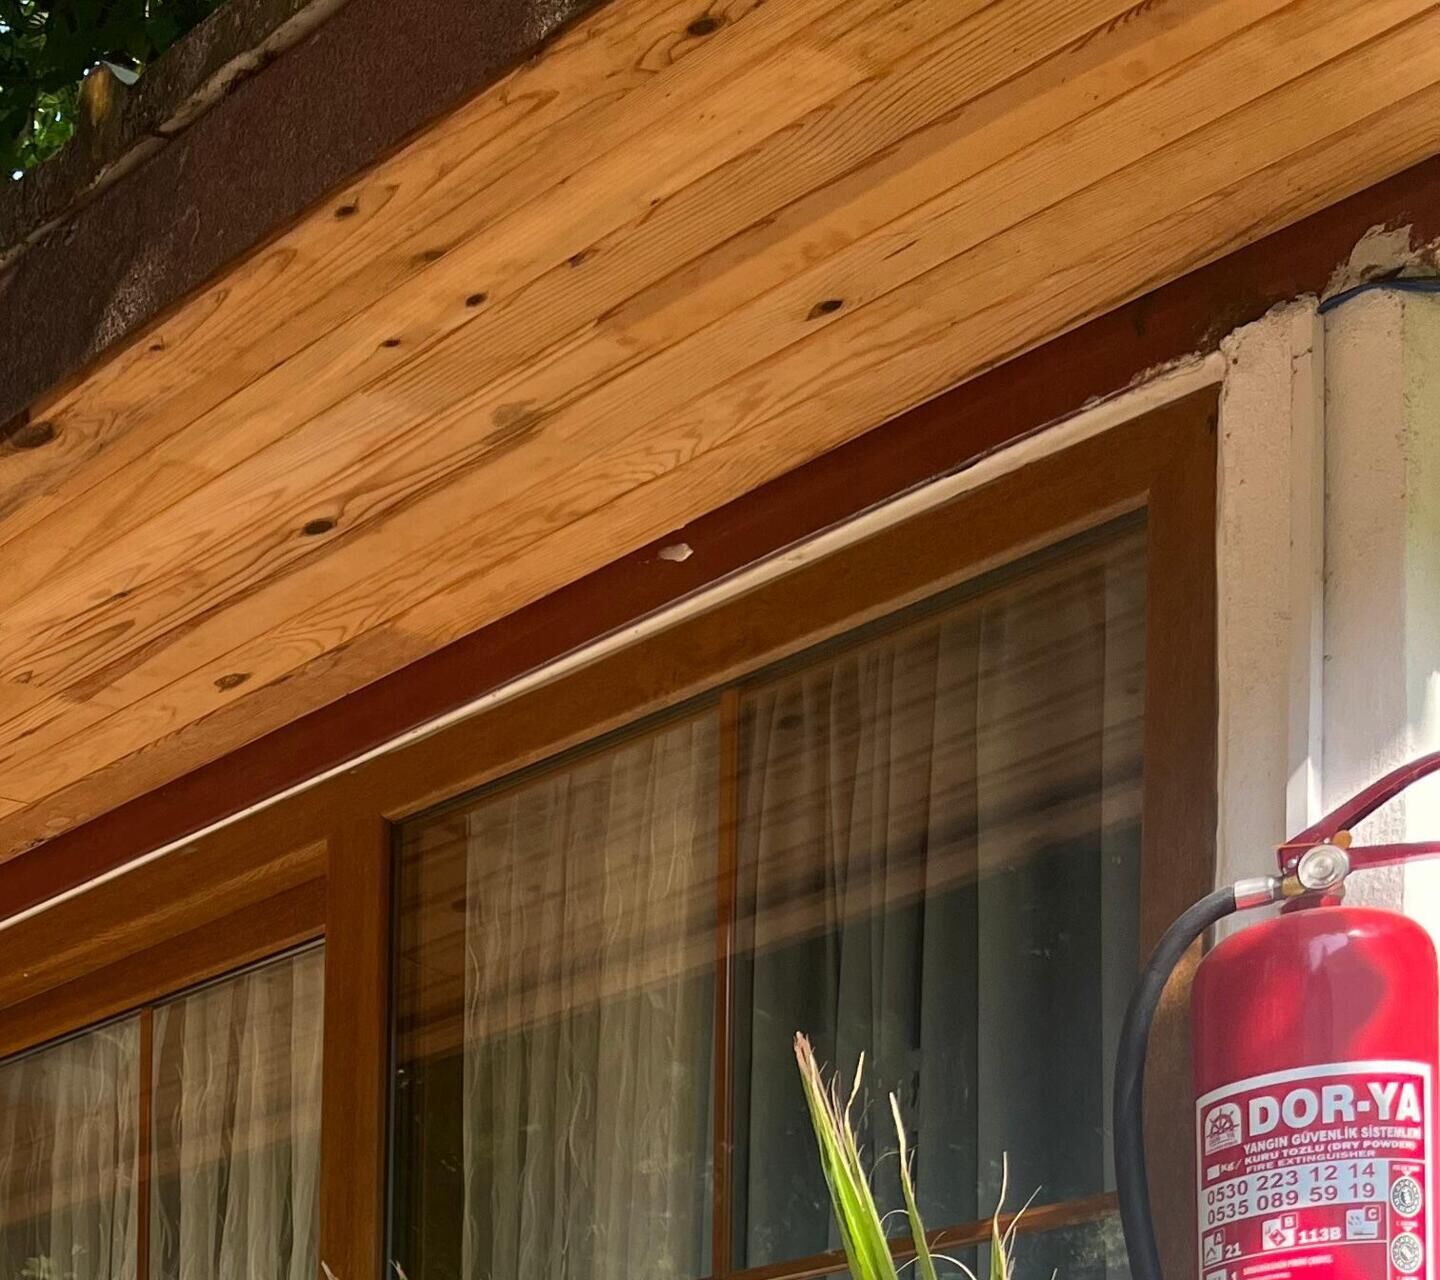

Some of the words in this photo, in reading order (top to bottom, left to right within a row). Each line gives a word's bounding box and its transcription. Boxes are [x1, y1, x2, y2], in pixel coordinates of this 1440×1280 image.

[1249, 1082, 1421, 1136] DOR-YA
[1243, 1136, 1288, 1155] YANGIN
[1292, 1126, 1357, 1144] GÜVENLİK
[1245, 1150, 1279, 1165] KURU
[1283, 1144, 1325, 1157] TOZLU
[1327, 1141, 1360, 1153] (DRY
[1246, 1161, 1274, 1174] FIRE
[1278, 1150, 1375, 1167] EXTINGUISHER
[1208, 1180, 1248, 1206] 0530
[1256, 1170, 1298, 1192] 223
[1310, 1165, 1338, 1182] 12
[1349, 1162, 1375, 1178] 14
[1208, 1200, 1249, 1225] 0535
[1256, 1190, 1298, 1211] 089
[1310, 1185, 1338, 1202] 59
[1349, 1183, 1375, 1199] 19
[1367, 1208, 1377, 1219] C
[1284, 1215, 1295, 1228] B
[1214, 1230, 1223, 1244] A
[1298, 1226, 1342, 1243] 113B
[1225, 1242, 1242, 1258] 21
